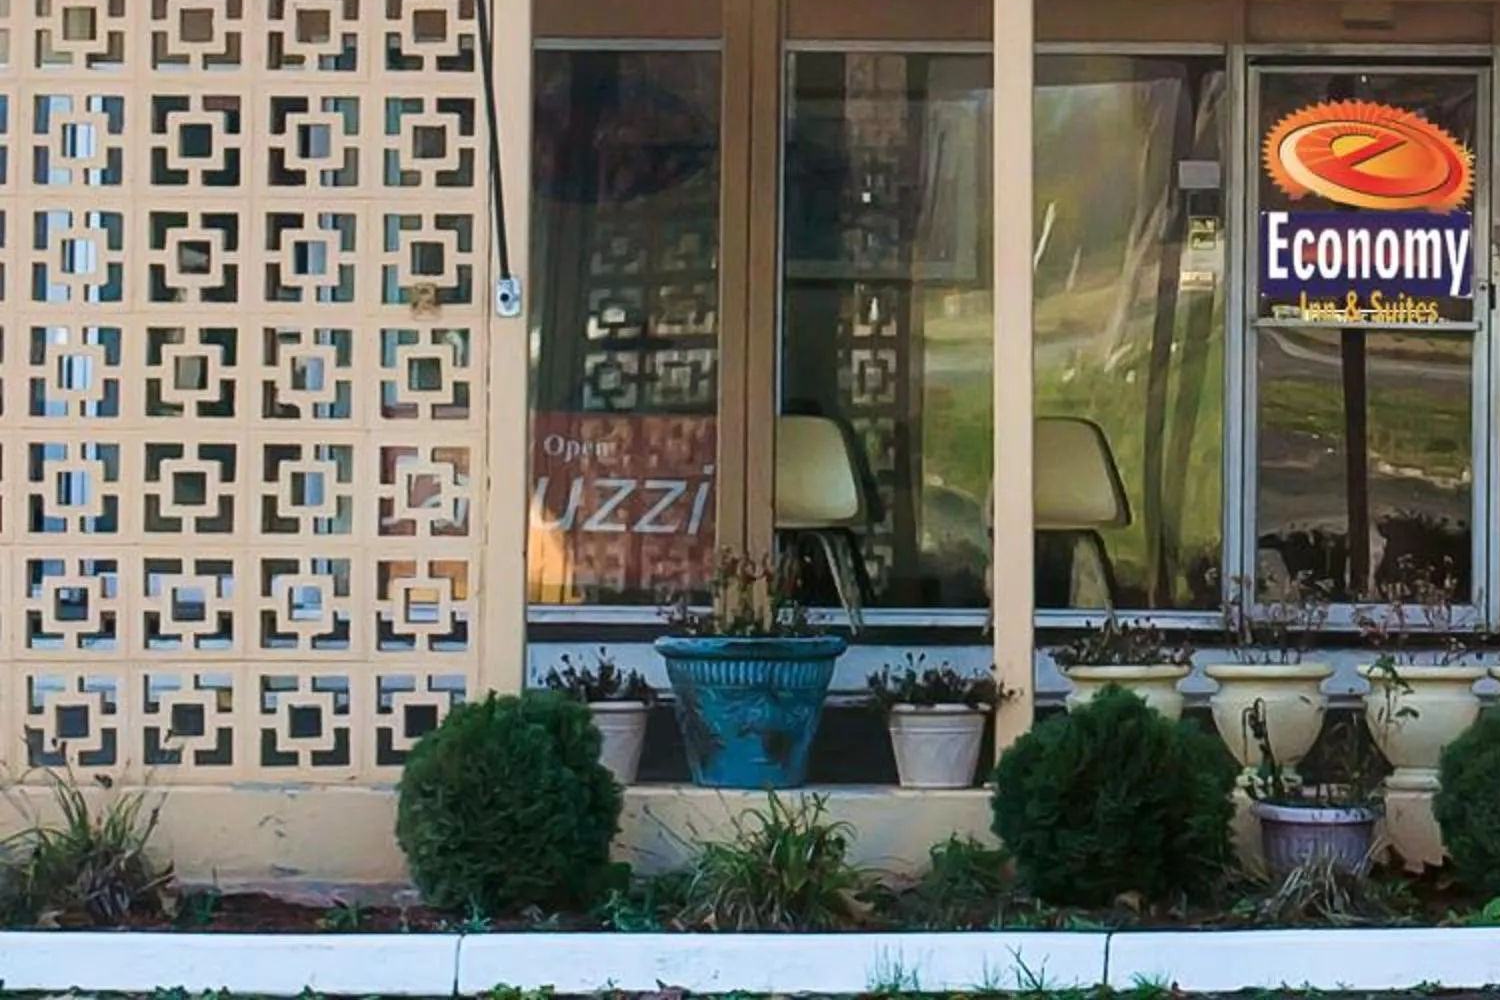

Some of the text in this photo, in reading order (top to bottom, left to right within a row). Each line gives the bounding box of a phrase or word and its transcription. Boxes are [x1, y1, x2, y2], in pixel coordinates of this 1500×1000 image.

[1268, 212, 1470, 296] Economy
[1345, 289, 1362, 321] &
[1370, 290, 1439, 323] Suites
[543, 434, 609, 462] Open
